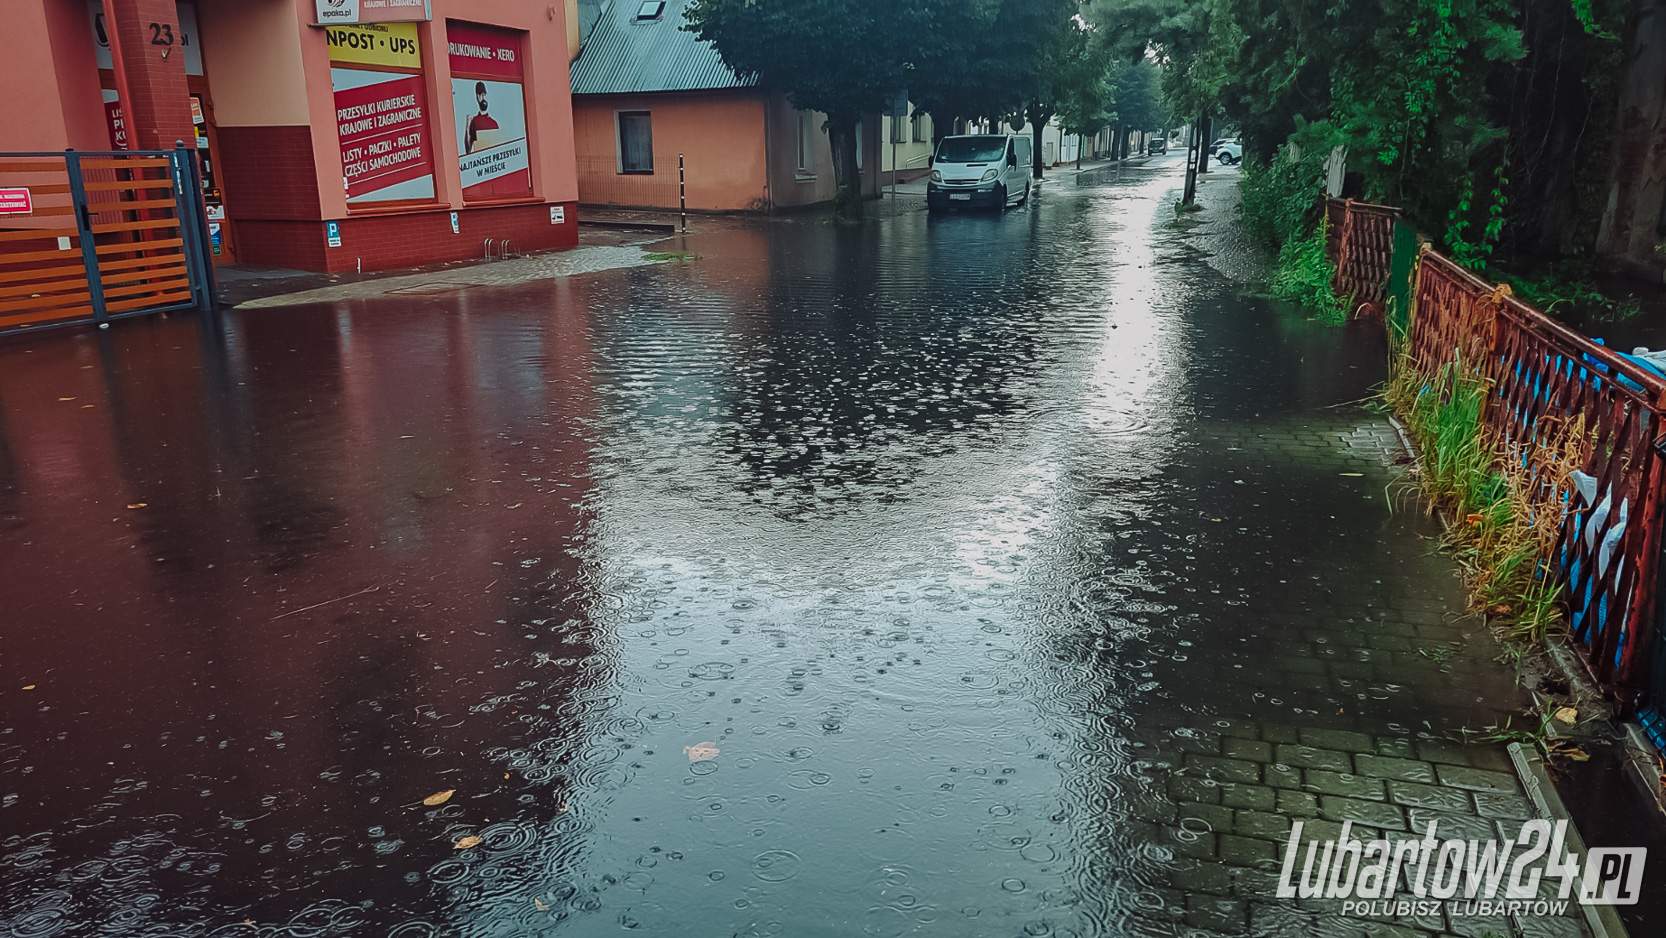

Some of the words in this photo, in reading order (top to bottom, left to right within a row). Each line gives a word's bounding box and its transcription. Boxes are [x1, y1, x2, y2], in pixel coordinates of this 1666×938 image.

[322, 9, 352, 18] epaka.pl
[149, 22, 175, 46] 23
[389, 36, 416, 55] UPS
[497, 47, 515, 62] XERO
[337, 103, 376, 122] PRZESYŁKI
[377, 94, 416, 112] KURIERSKIE
[339, 118, 373, 136] KRAJOWE
[378, 107, 422, 127] ZAGRANICZNE
[342, 147, 362, 163] LISTY
[369, 140, 392, 156] PACZKI
[397, 133, 421, 148] PALETY
[344, 159, 369, 177] CZĘŚCI
[370, 147, 421, 171] SAMOCHODOWE
[476, 169, 483, 177] W
[330, 223, 337, 236] P
